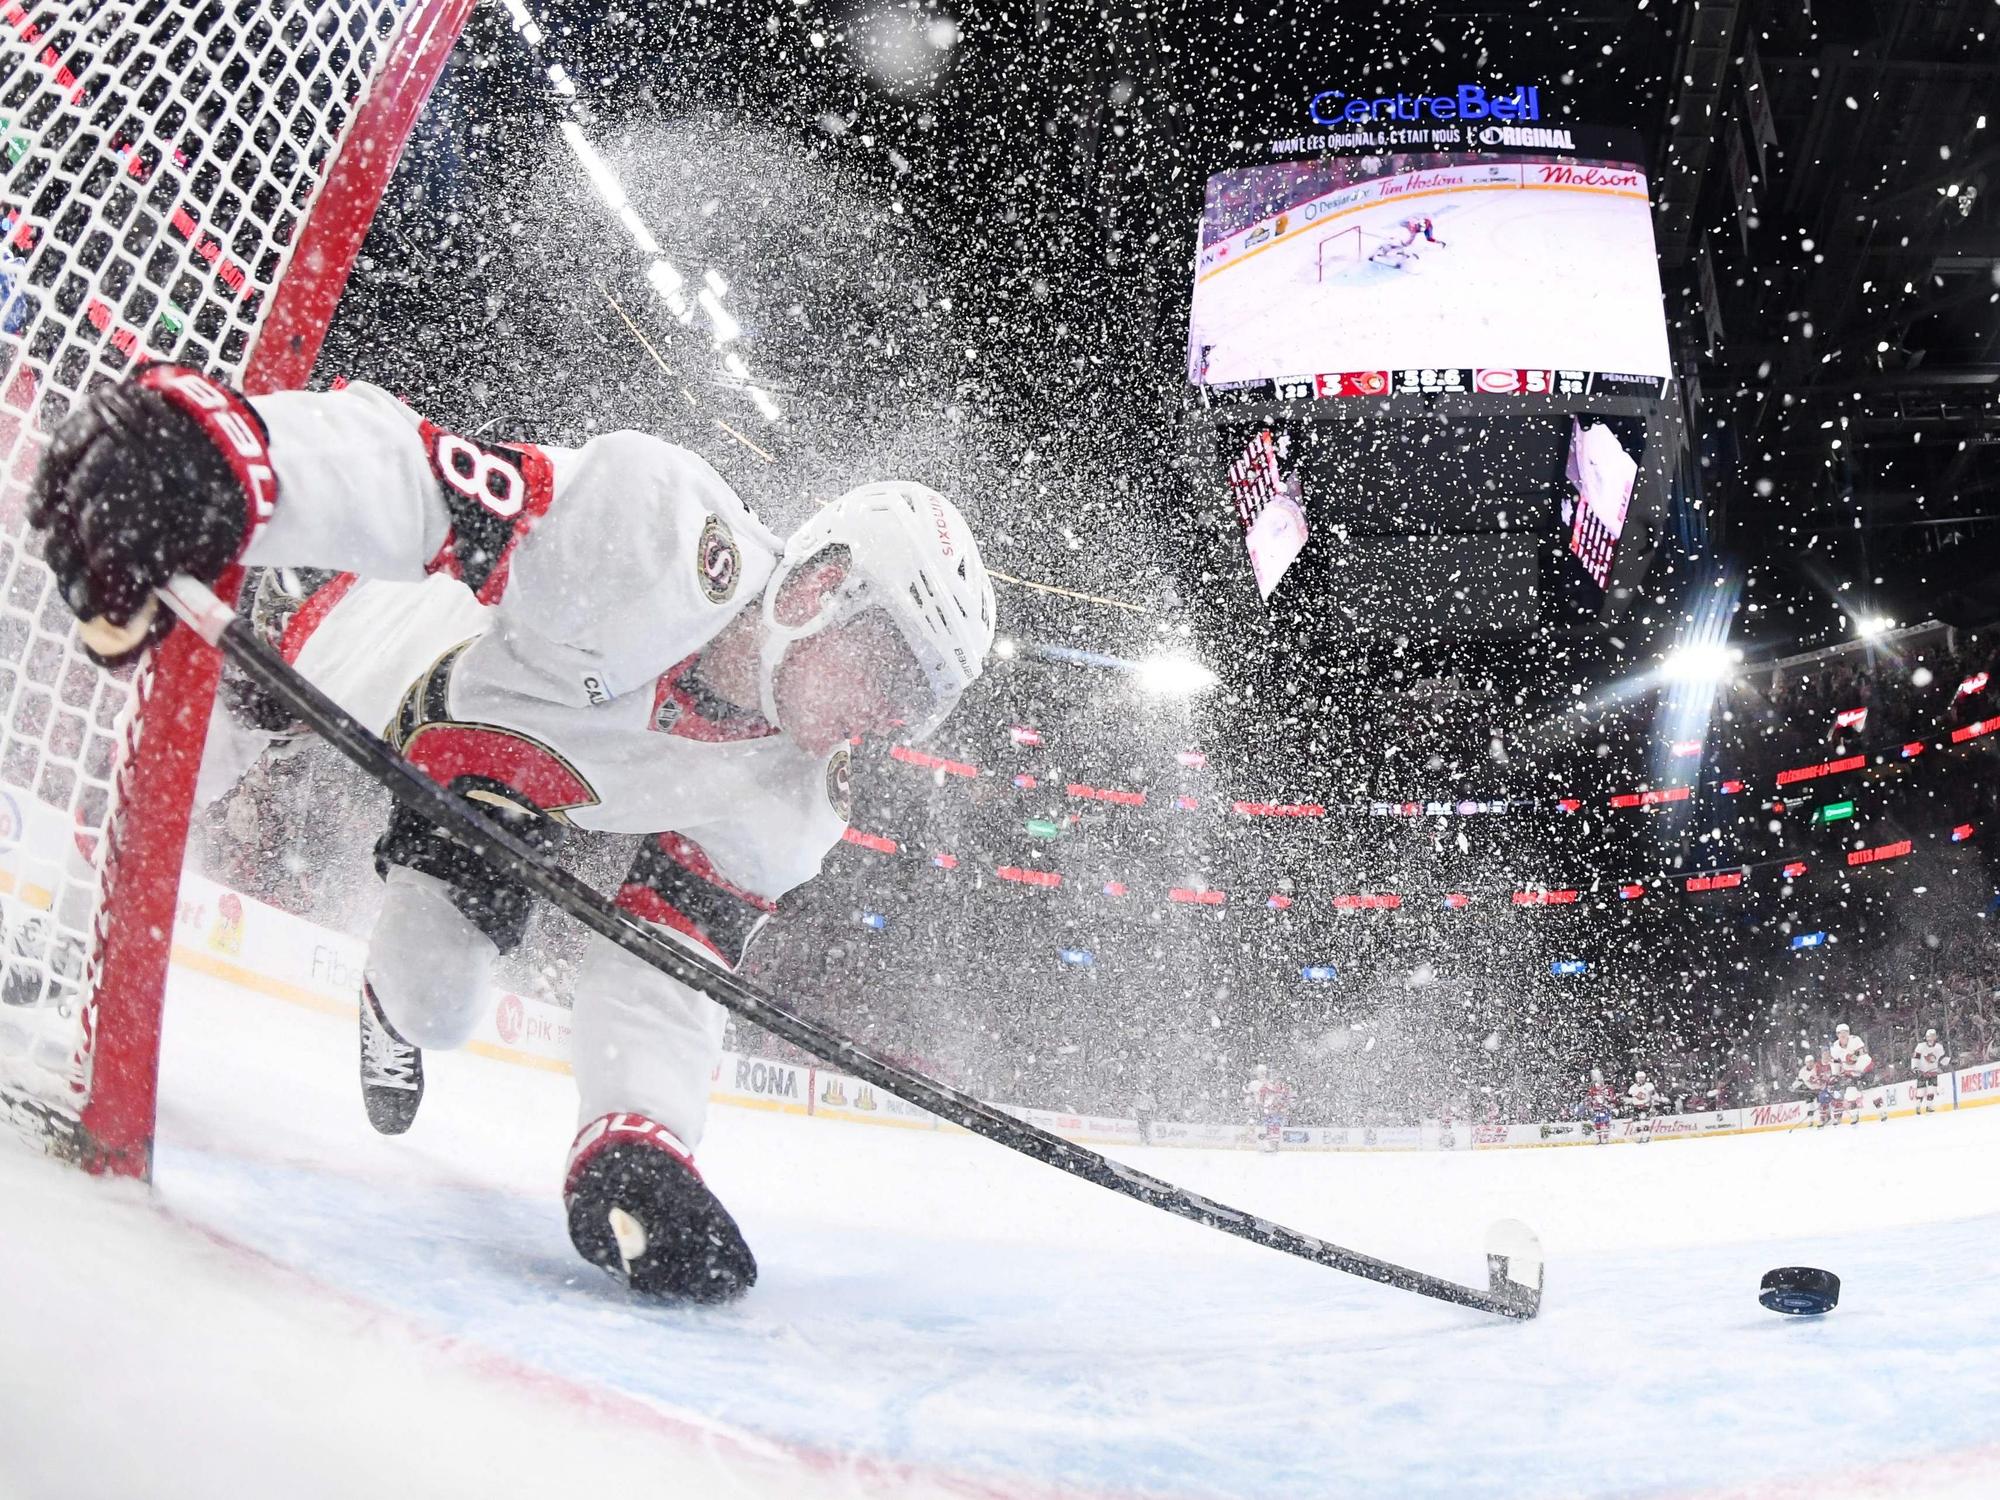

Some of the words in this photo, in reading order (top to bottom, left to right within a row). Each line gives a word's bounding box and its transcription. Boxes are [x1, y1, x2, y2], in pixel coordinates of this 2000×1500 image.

[1328, 131, 1375, 148] ORIGINAL
[1431, 128, 1461, 143] NOUS
[1538, 164, 1638, 187] Molson
[1378, 178, 1402, 196] Tim
[1321, 374, 1343, 396] 3
[1526, 370, 1546, 392] 5
[438, 434, 525, 517] 8
[735, 1059, 799, 1098] RONA
